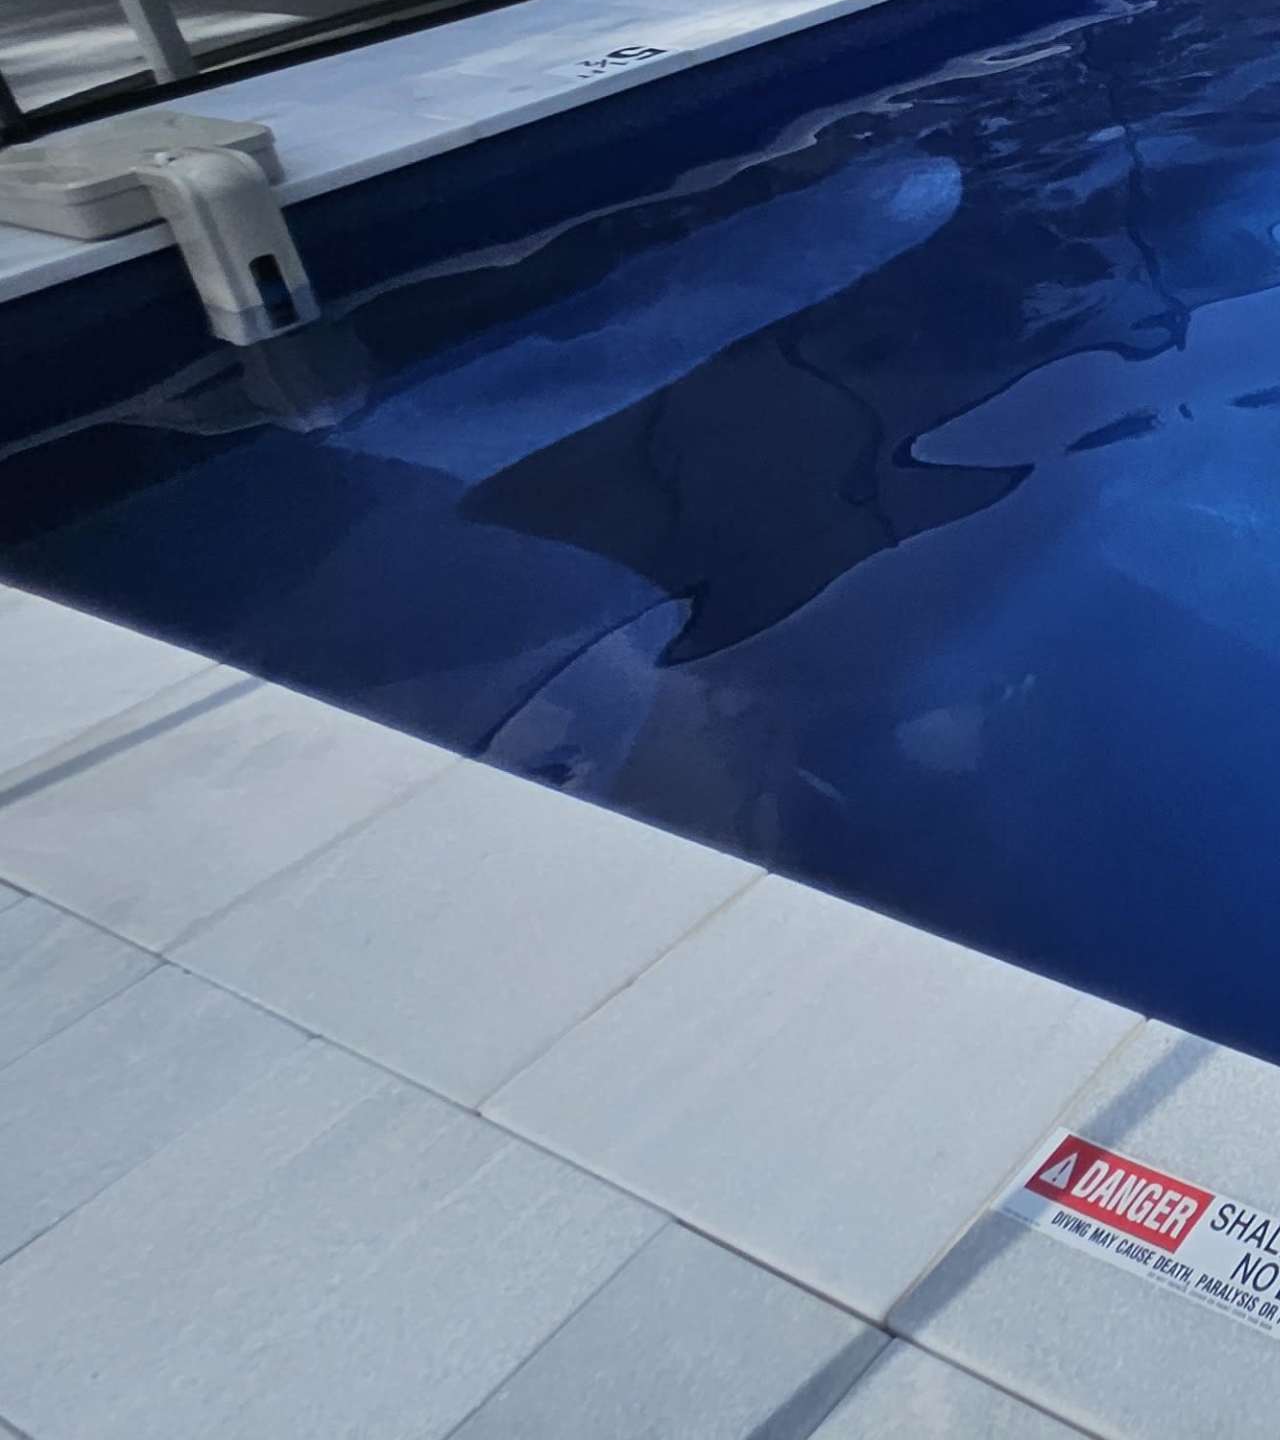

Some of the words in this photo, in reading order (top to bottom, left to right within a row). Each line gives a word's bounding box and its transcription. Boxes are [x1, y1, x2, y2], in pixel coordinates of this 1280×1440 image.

[606, 45, 668, 61] 5
[1070, 1159, 1199, 1239] DANGER
[1051, 1210, 1092, 1238] DIVING
[1088, 1227, 1120, 1249] MAY
[1115, 1238, 1156, 1266] CAUSE
[1152, 1255, 1195, 1286] DEATH,
[1194, 1273, 1260, 1312] PARALYSIS
[1258, 1301, 1279, 1321] OR
[1230, 1252, 1280, 1292] NO
